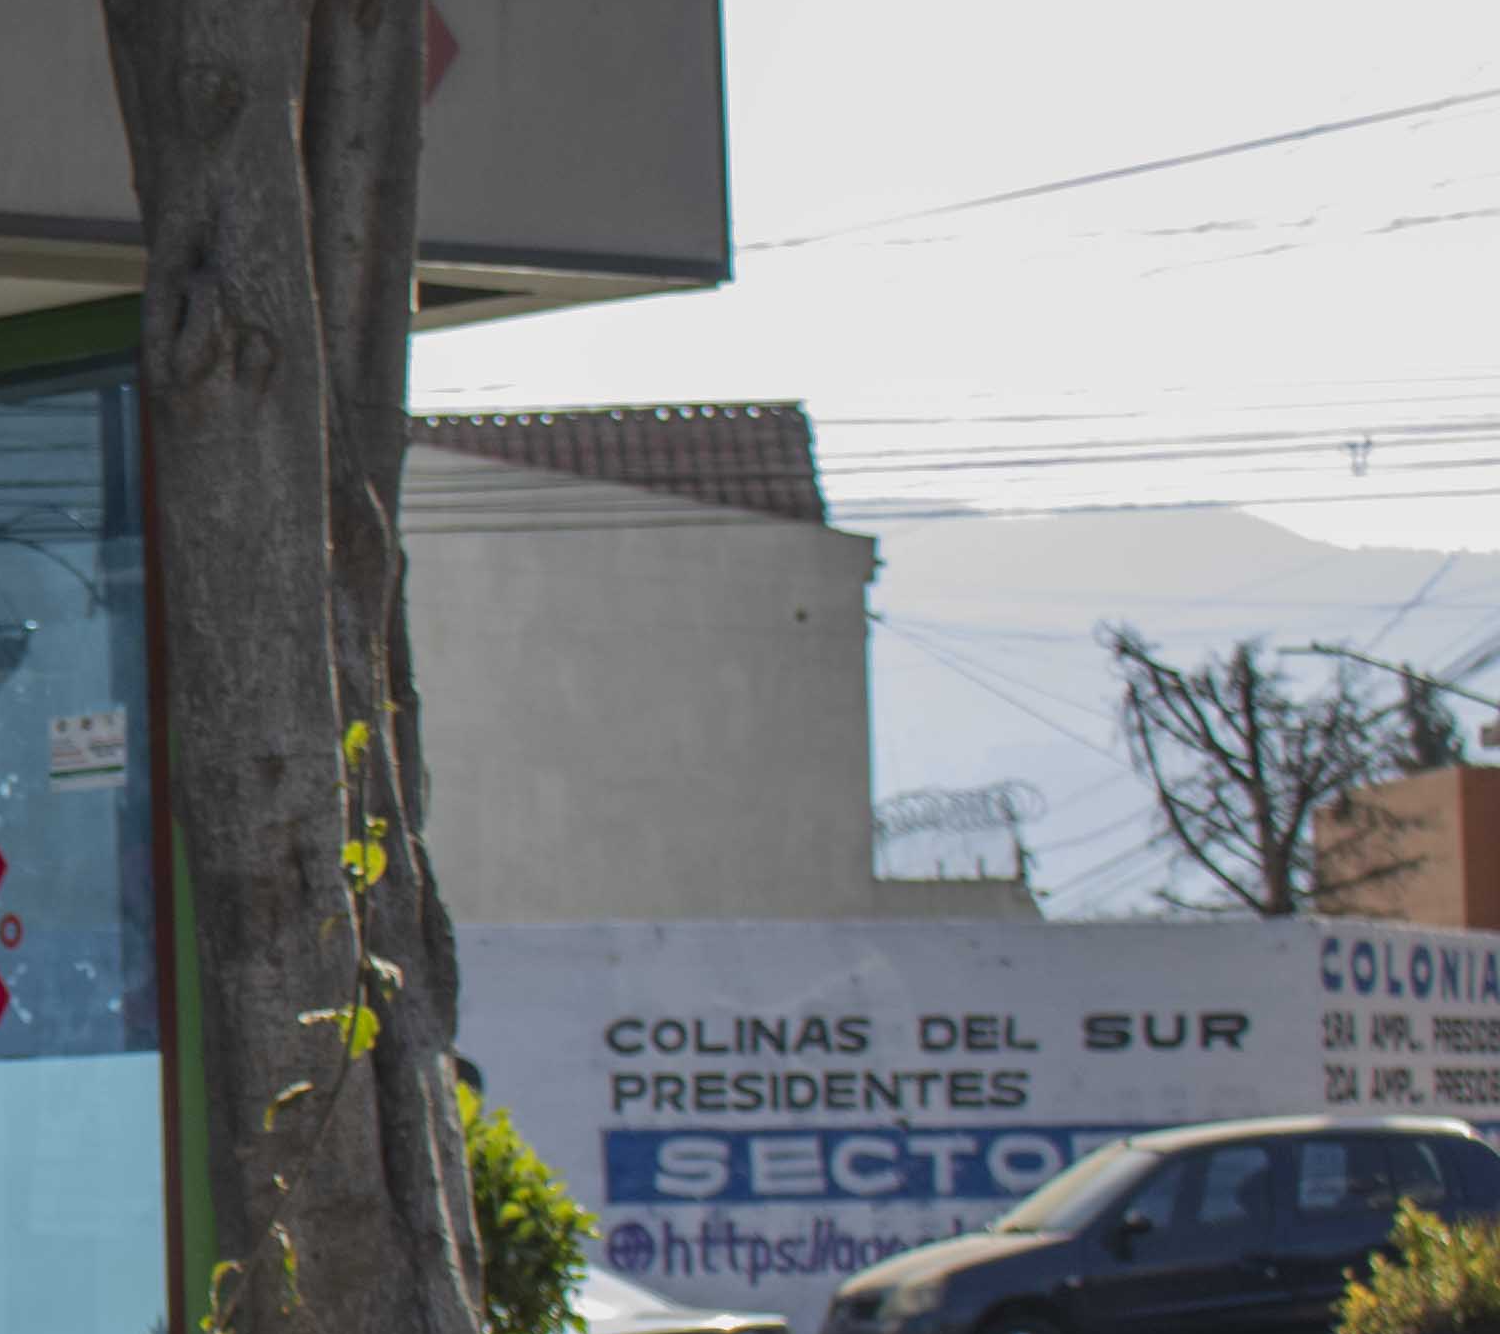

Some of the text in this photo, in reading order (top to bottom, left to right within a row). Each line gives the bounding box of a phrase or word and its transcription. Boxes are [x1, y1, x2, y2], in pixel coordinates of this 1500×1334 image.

[602, 1013, 1251, 1057] COLINAS DEL SUR
[608, 1069, 1031, 1113] PRESIDENTES
